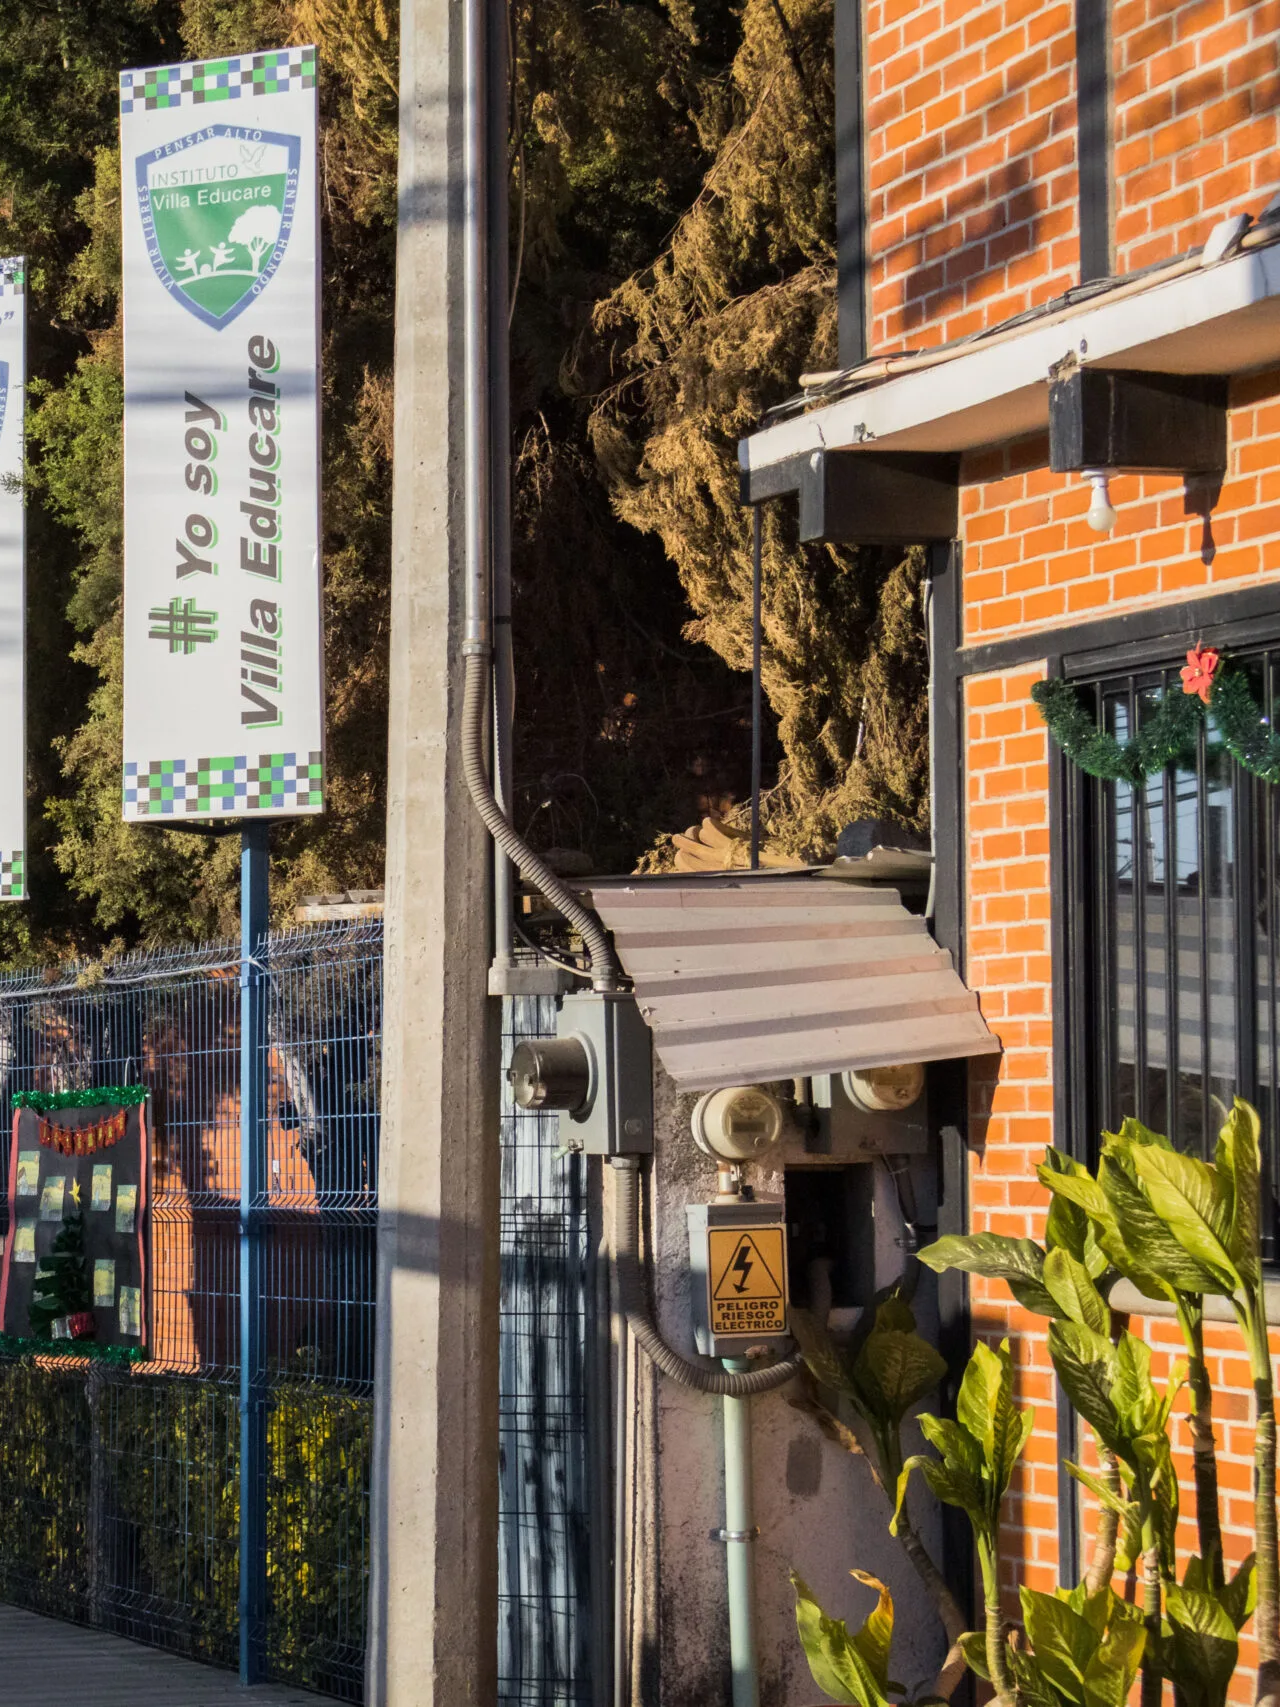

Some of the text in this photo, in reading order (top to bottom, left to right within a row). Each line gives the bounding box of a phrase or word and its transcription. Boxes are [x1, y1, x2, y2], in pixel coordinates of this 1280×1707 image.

[154, 126, 263, 160] PENSAR ALTO
[152, 164, 239, 187] INSTITUTO
[153, 184, 272, 211] Villa Educare
[137, 184, 177, 290] VIVIR LIBRES
[252, 168, 298, 295] SENTIR HONDO
[183, 390, 228, 497] soy
[175, 513, 219, 580] Yo
[239, 334, 283, 729] Villa Educare
[716, 1301, 779, 1312] PELIGRO
[721, 1311, 775, 1320] RIESGO
[714, 1320, 783, 1331] ELECTRICO
